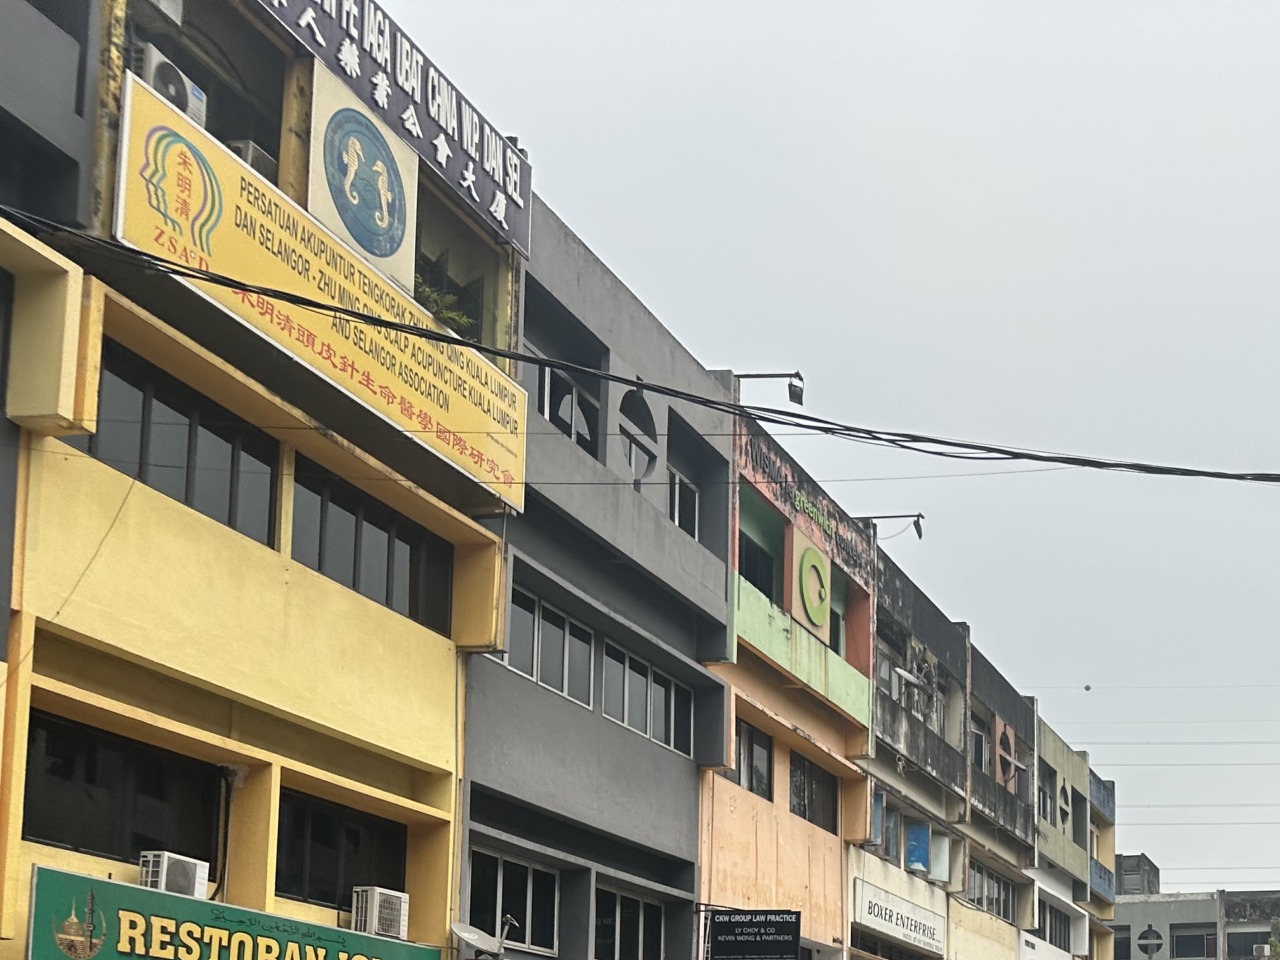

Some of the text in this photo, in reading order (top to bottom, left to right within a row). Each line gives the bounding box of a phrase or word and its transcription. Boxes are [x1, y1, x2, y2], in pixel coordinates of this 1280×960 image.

[395, 32, 423, 104] UBAT
[428, 67, 458, 141] CHINA
[483, 123, 503, 186] DAN
[234, 204, 256, 241] DAN
[258, 224, 310, 282] SELANGOR
[318, 269, 336, 303] ZHU
[411, 342, 467, 398] ACUPUNCTURE
[468, 386, 491, 418] KUALA
[492, 404, 518, 438] LUMPUR
[240, 176, 298, 240] PERSATUAN
[299, 224, 355, 284] AKUPUNTUR
[357, 268, 407, 324] TENGKORAK
[466, 356, 489, 388] KUALA
[490, 372, 517, 412] LUMPUR
[331, 312, 449, 413] AND SELANGOR ASSOCIATION
[730, 914, 752, 922] GROUP
[752, 914, 766, 922] LAW
[767, 914, 797, 922] PRACTICE
[868, 900, 936, 940] BOXER ENTERPRISE
